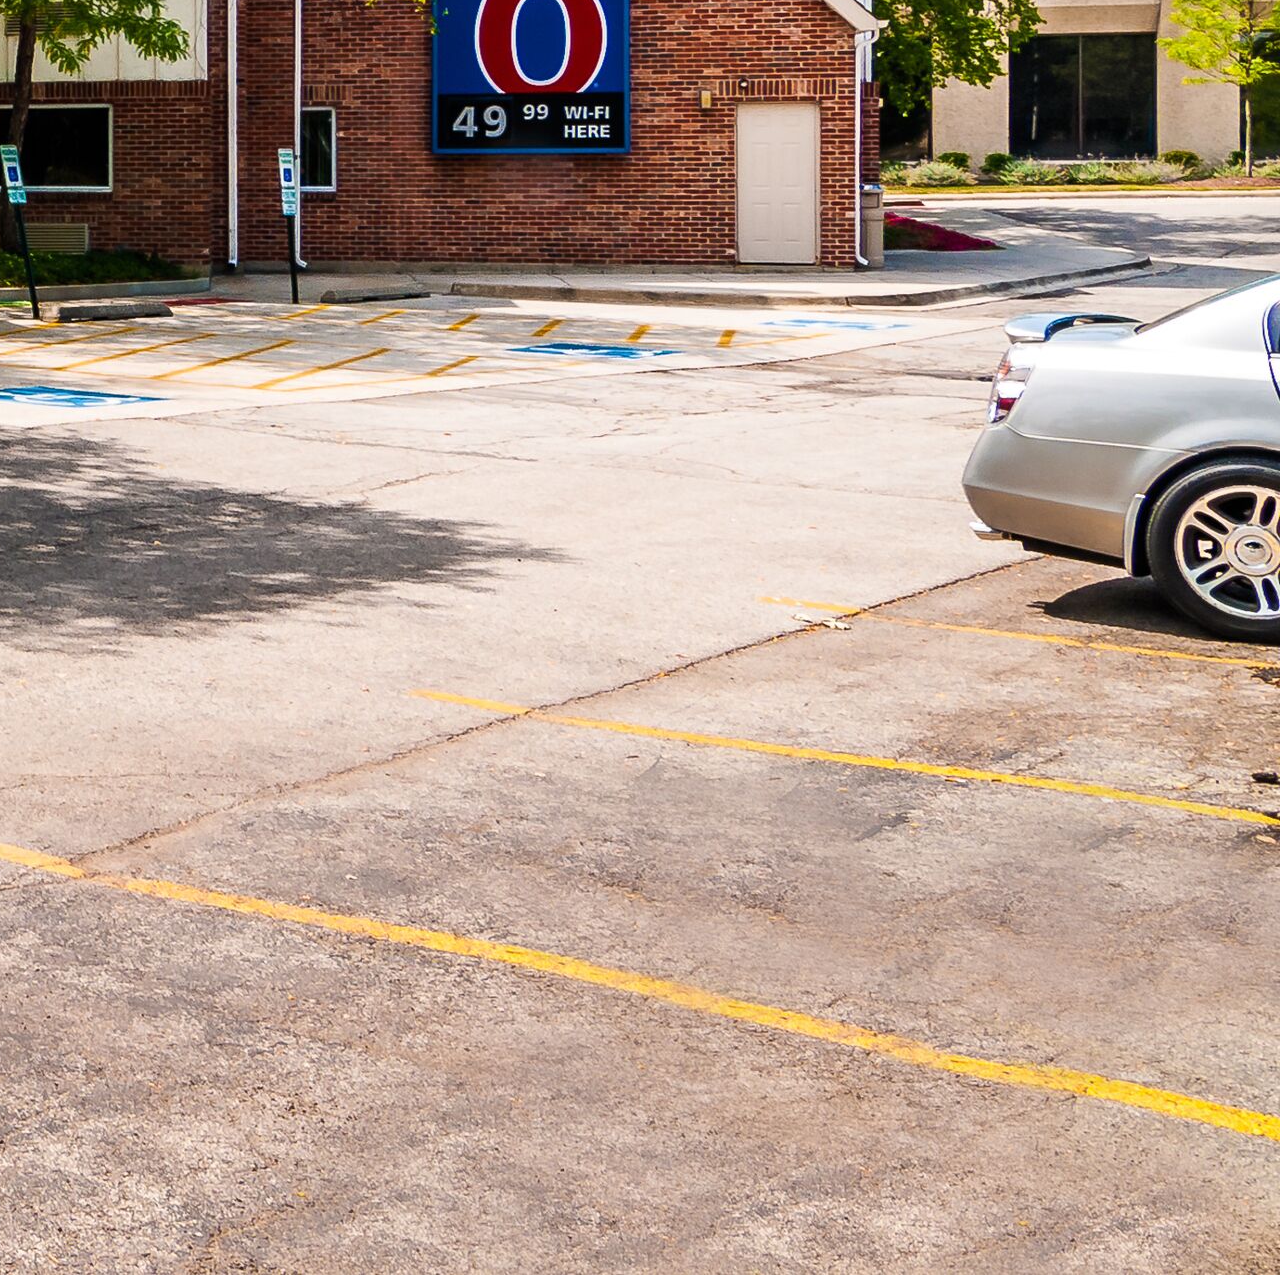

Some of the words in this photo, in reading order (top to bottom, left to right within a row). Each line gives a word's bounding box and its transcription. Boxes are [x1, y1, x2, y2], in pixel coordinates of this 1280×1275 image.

[564, 106, 610, 120] WI-FI
[452, 105, 507, 138] 49
[522, 104, 549, 120] 99
[564, 125, 610, 138] HERE
